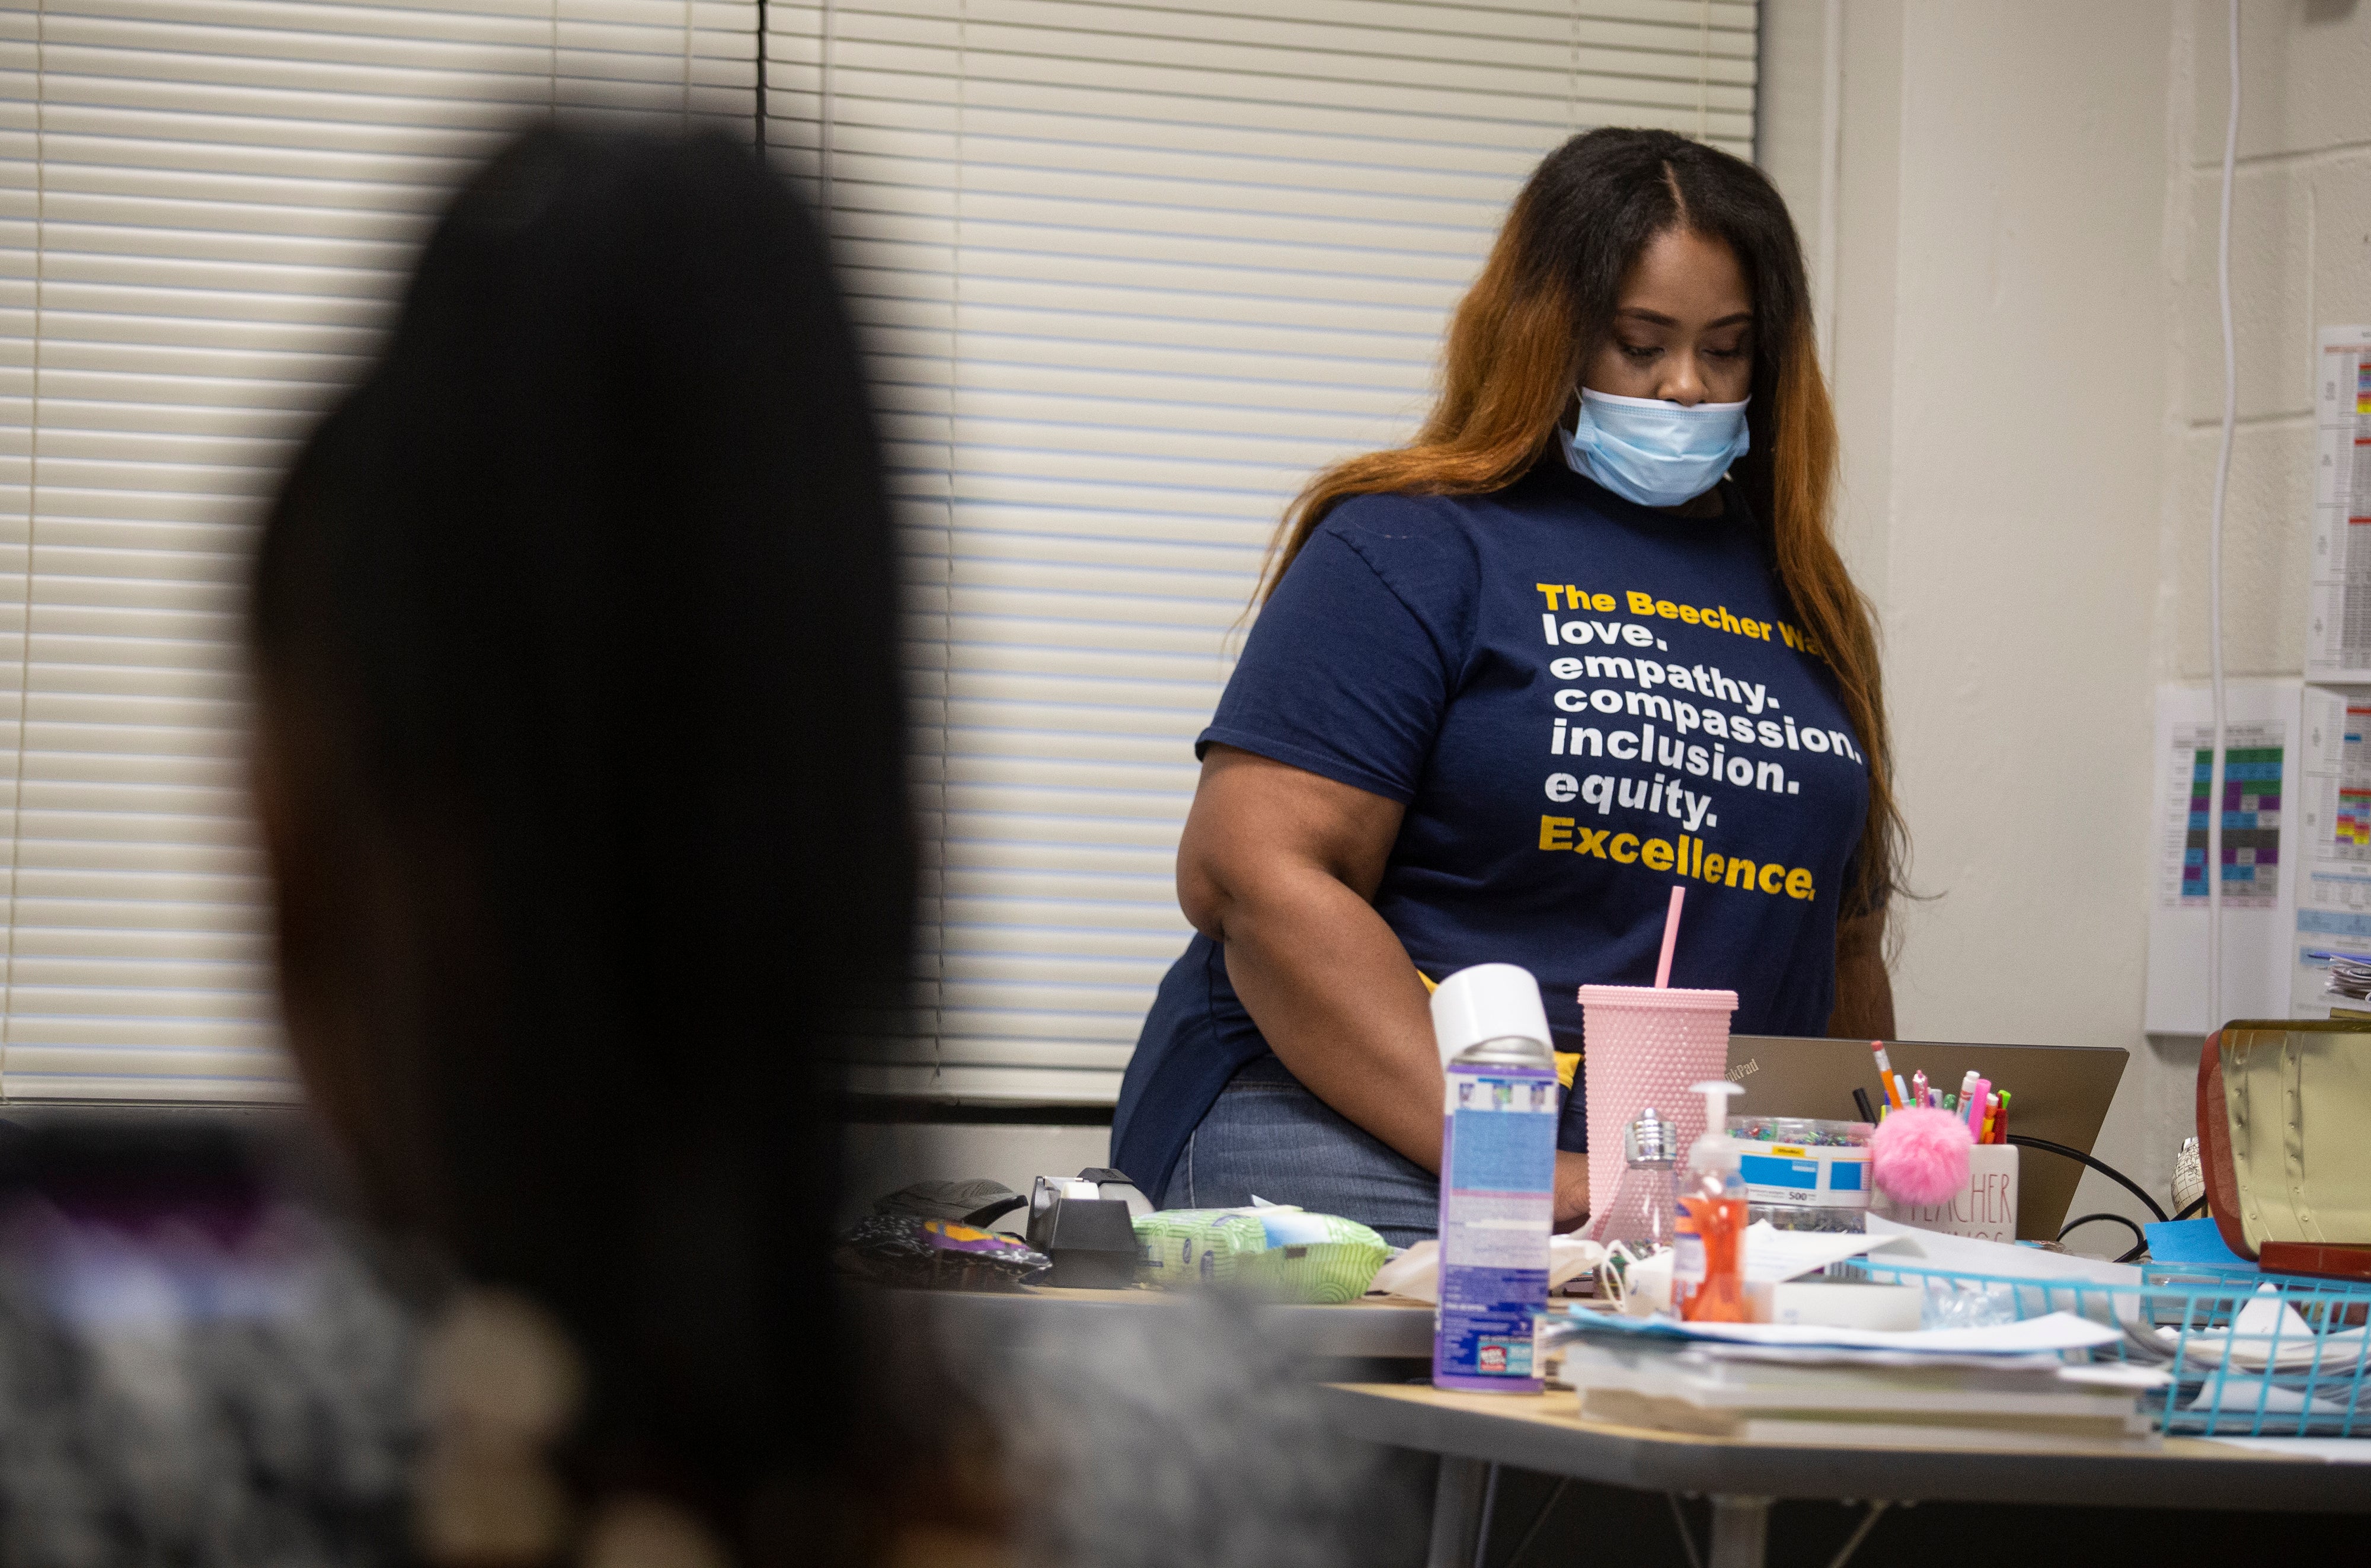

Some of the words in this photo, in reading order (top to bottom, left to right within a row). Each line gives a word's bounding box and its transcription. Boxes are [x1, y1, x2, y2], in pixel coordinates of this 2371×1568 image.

[1536, 583, 1616, 612] The
[1626, 590, 1772, 641] Beecher
[1777, 620, 1823, 656] Wa
[1542, 613, 1668, 652] love.
[1549, 655, 1780, 715] empathy.
[1551, 718, 1800, 795] inclusion.
[1553, 688, 1863, 765] compassion.
[1545, 772, 1718, 831] equity.
[1539, 814, 1816, 902] Excellence.
[1725, 1058, 1759, 1082] nkPad
[1788, 1191, 1808, 1201] 500
